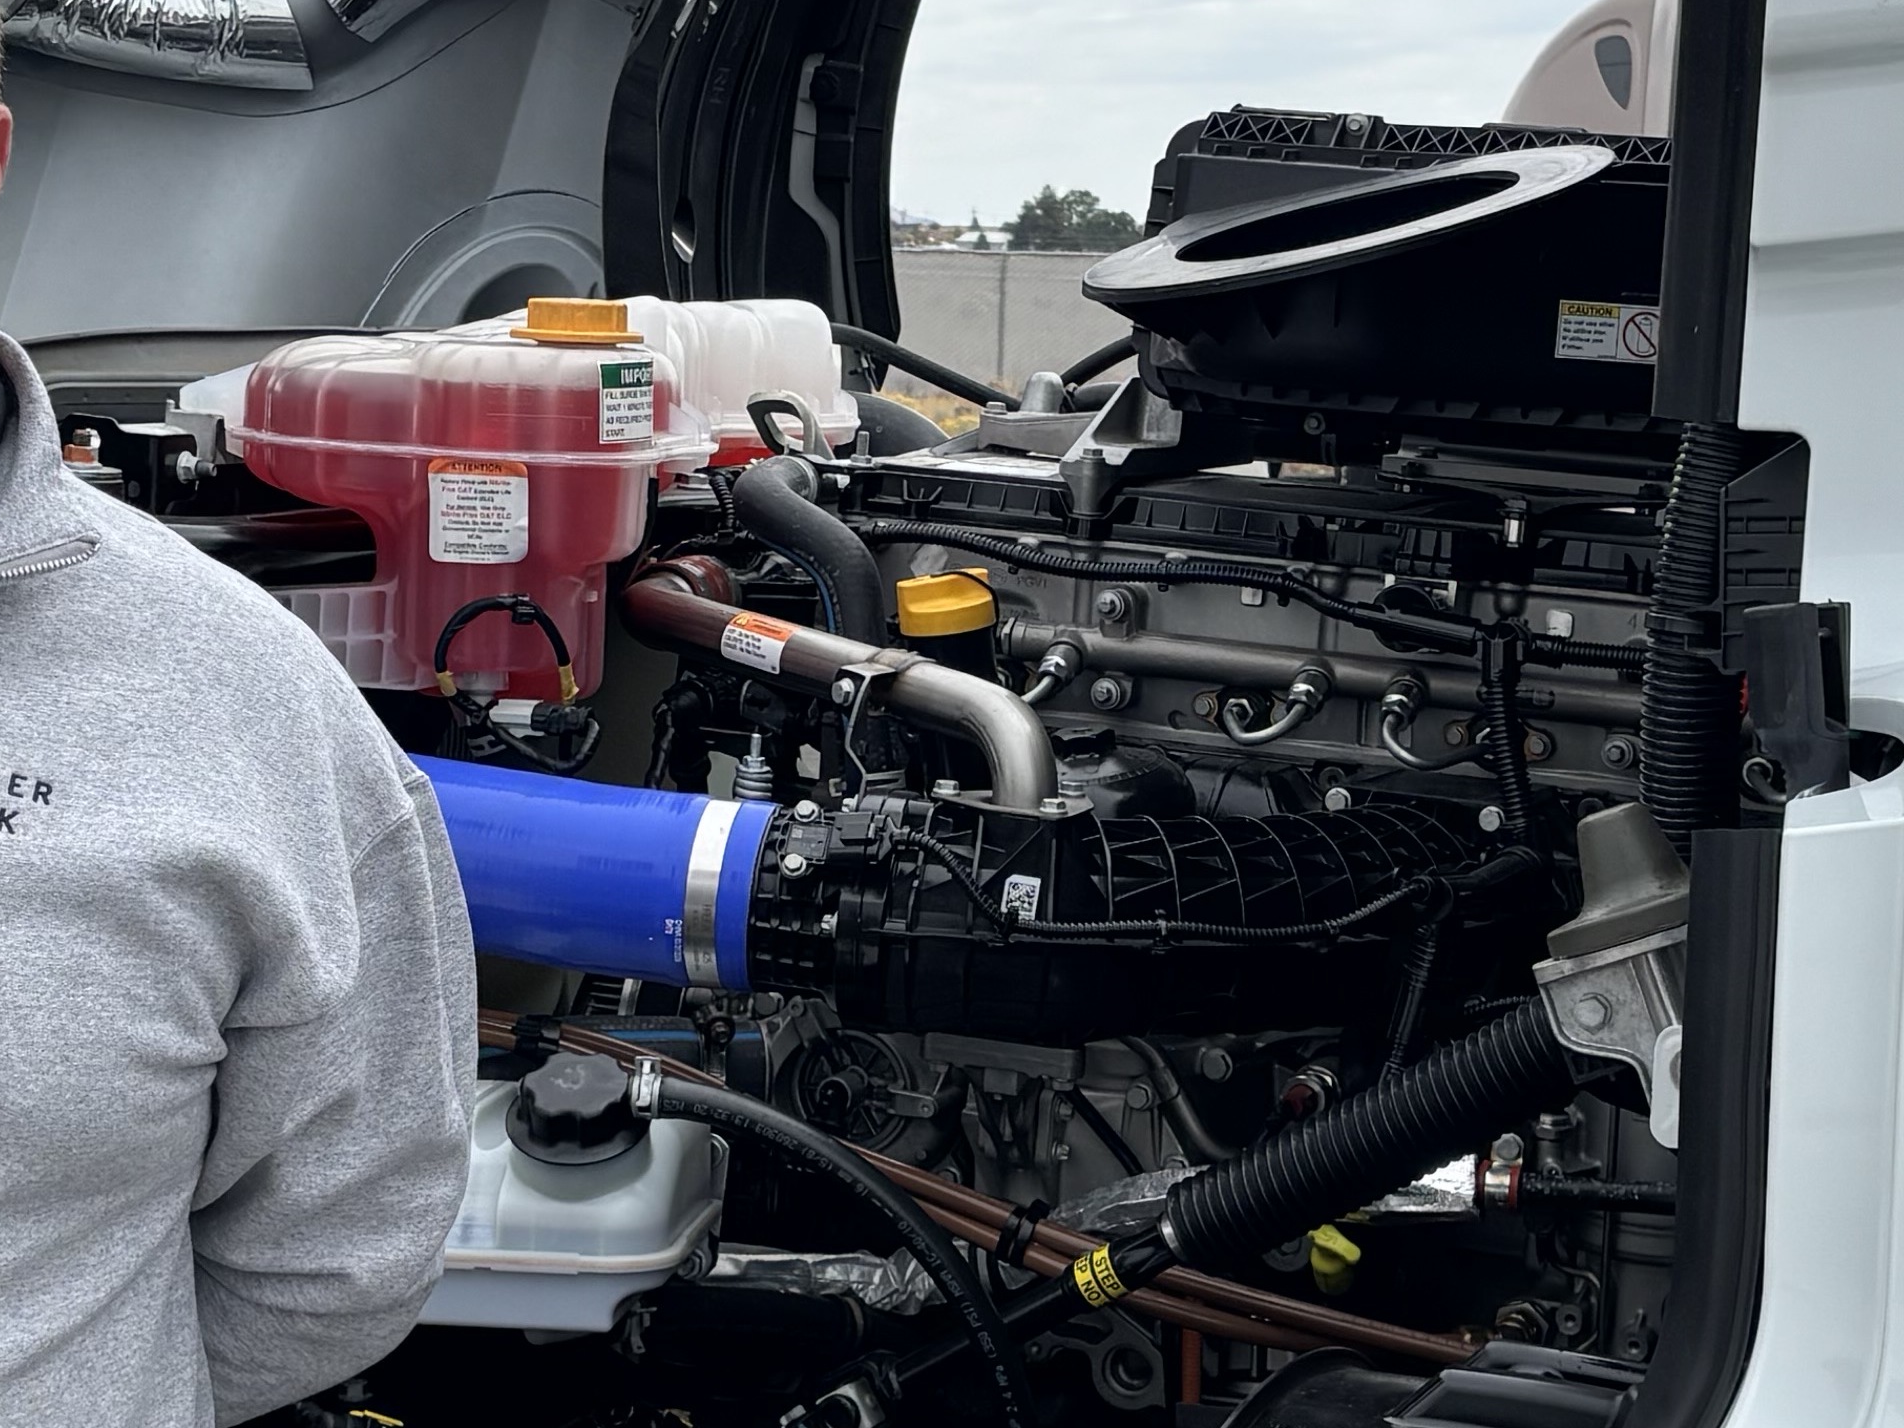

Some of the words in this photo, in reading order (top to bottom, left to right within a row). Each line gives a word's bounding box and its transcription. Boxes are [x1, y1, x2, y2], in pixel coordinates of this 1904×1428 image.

[1568, 305, 1613, 316] CAUTION
[1095, 1256, 1121, 1291] STEP
[1081, 1282, 1101, 1301] NO
